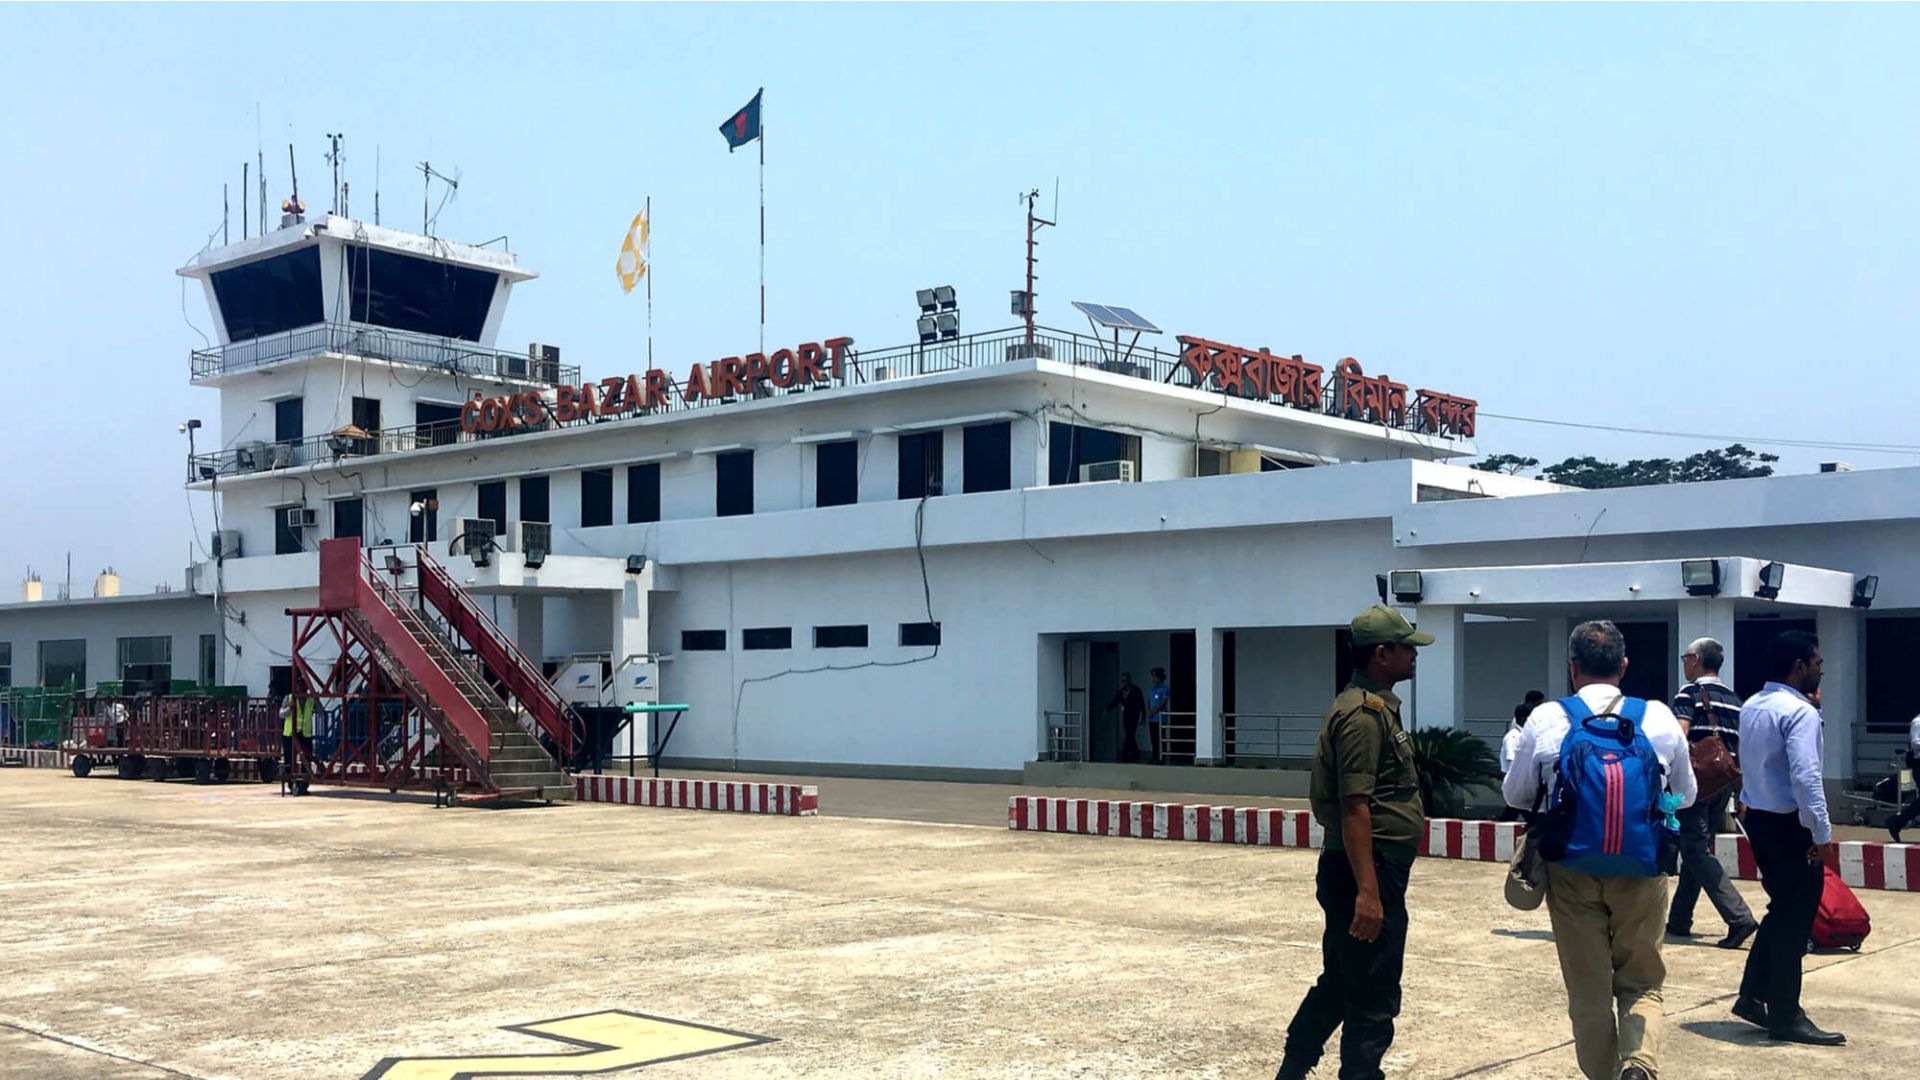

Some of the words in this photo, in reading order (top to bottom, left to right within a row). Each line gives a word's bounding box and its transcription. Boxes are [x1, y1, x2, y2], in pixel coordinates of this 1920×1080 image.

[461, 390, 544, 433] COX'S
[556, 368, 669, 422] BAZAR
[685, 336, 852, 402] AIRPORT
[1176, 335, 1324, 407] কক্সবাজার
[1335, 357, 1408, 425] বিমান
[1416, 389, 1478, 438] বন্দর
